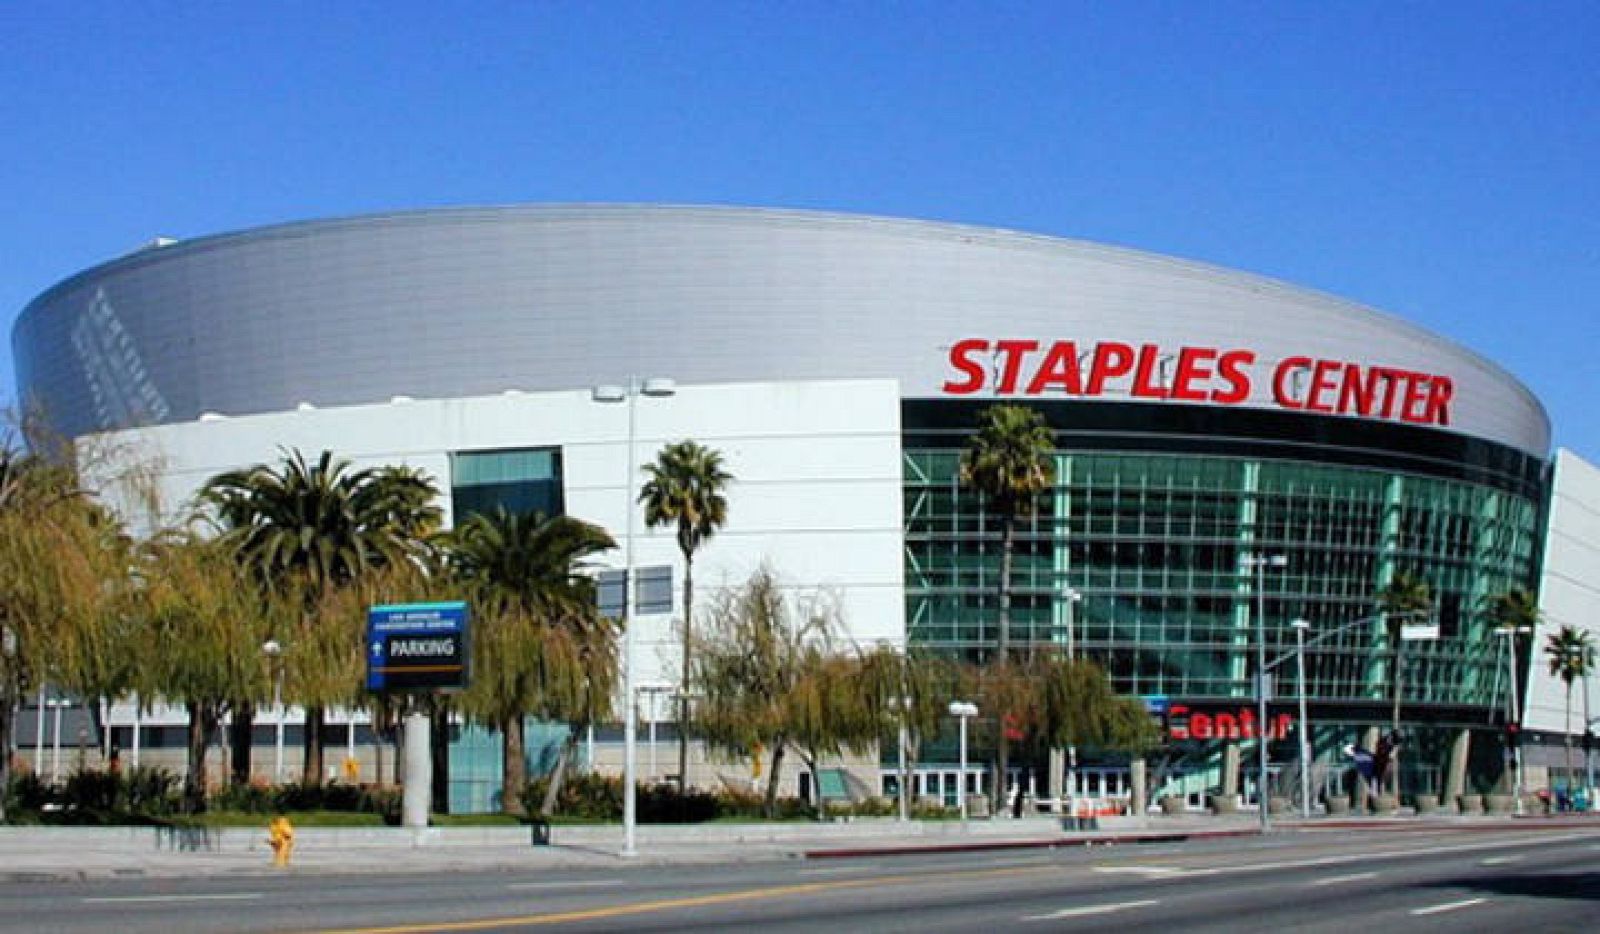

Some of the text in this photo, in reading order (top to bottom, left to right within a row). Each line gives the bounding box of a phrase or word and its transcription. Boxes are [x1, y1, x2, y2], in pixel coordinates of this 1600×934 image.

[942, 339, 1454, 425] STAPLES CENTER
[390, 638, 454, 656] PARKING
